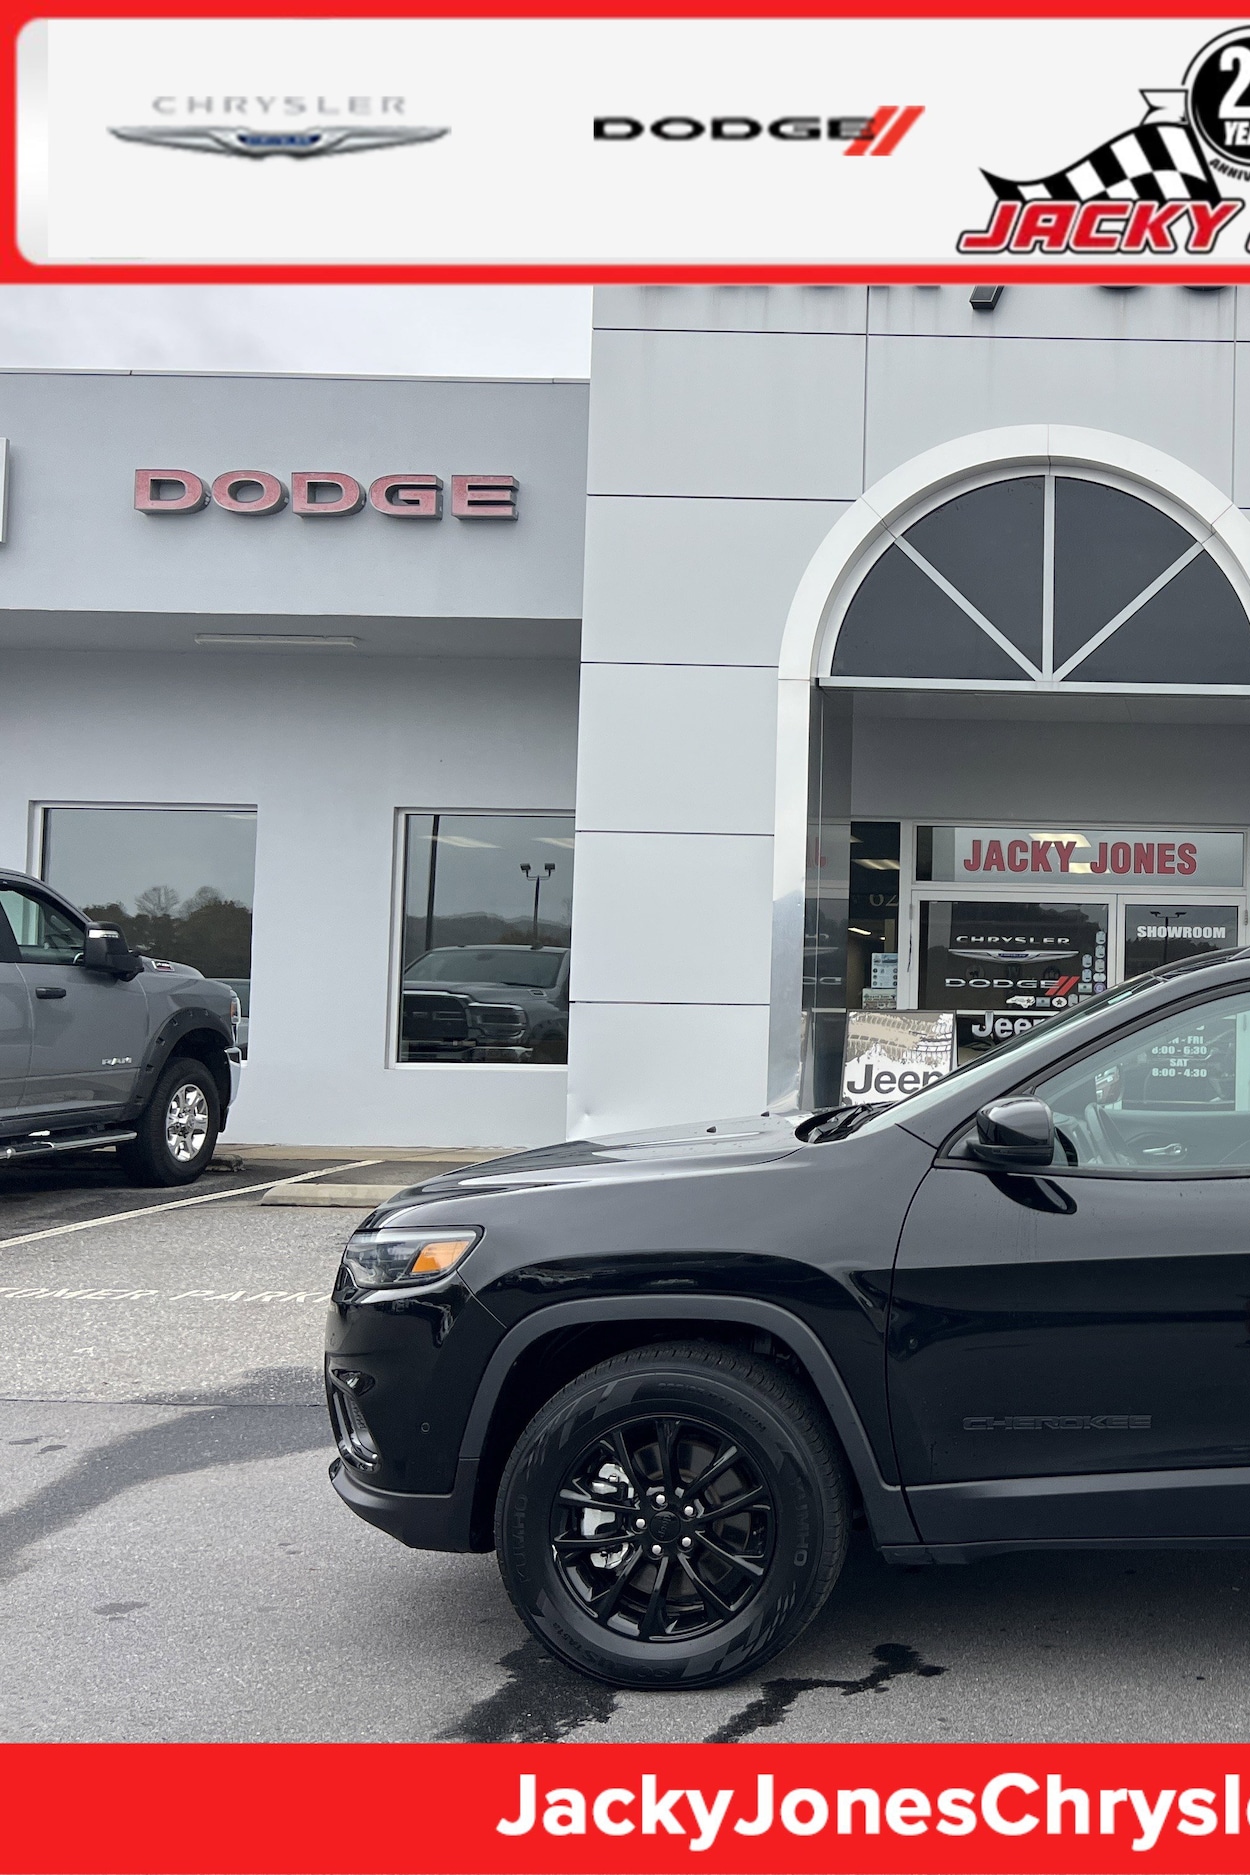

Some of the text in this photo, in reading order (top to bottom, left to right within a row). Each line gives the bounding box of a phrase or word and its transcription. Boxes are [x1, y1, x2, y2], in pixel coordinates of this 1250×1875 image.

[134, 469, 519, 521] DODGE
[964, 840, 1197, 875] JACKY JONES
[1136, 925, 1227, 940] SHOWROOM
[955, 935, 1071, 945] CHRYSLER
[945, 978, 1060, 990] DODGE
[972, 1011, 1045, 1039] Jee
[1187, 1036, 1204, 1044] FRI
[1183, 1046, 1207, 1055] 6:30
[101, 1056, 133, 1066] RAM
[1170, 1058, 1189, 1067] SAT
[1152, 1068, 1176, 1077] 8:00
[1183, 1069, 1207, 1078] 4:30
[962, 1414, 1152, 1431] CHEROKEE
